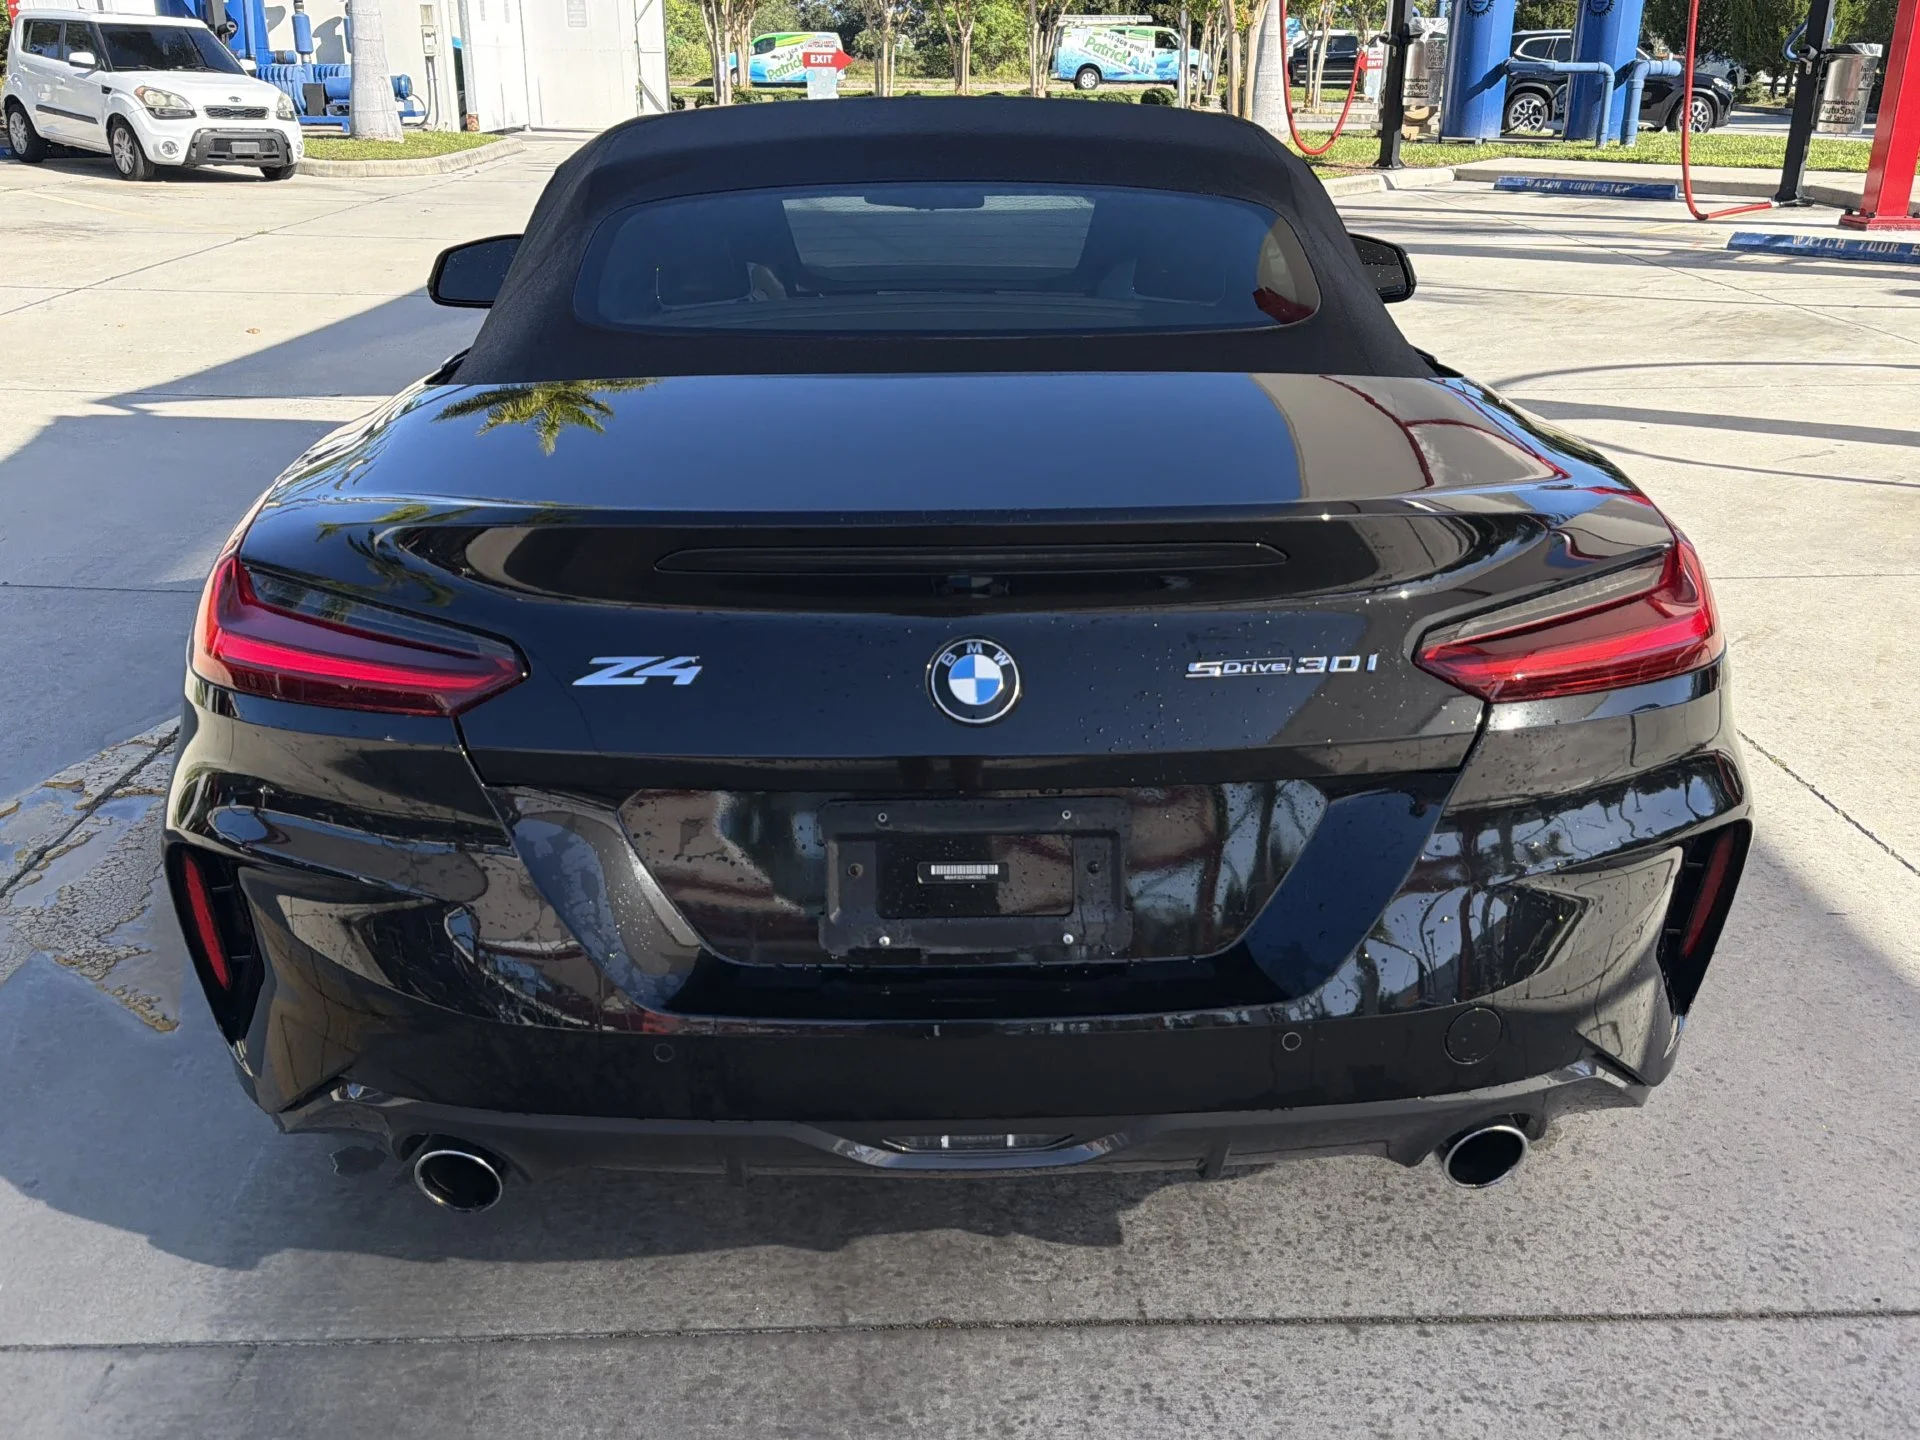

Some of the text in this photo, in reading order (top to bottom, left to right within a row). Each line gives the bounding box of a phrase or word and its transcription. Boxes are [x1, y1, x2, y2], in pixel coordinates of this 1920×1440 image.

[809, 54, 834, 64] EXIT
[1084, 35, 1129, 65] Patrick
[1127, 55, 1154, 75] Air
[1821, 105, 1856, 116] AutoSpa
[1569, 181, 1595, 192] YOUR
[1793, 234, 1847, 250] WATCH
[1858, 241, 1900, 253] YOUR
[941, 642, 1010, 667] BMW
[572, 656, 702, 685] Z4
